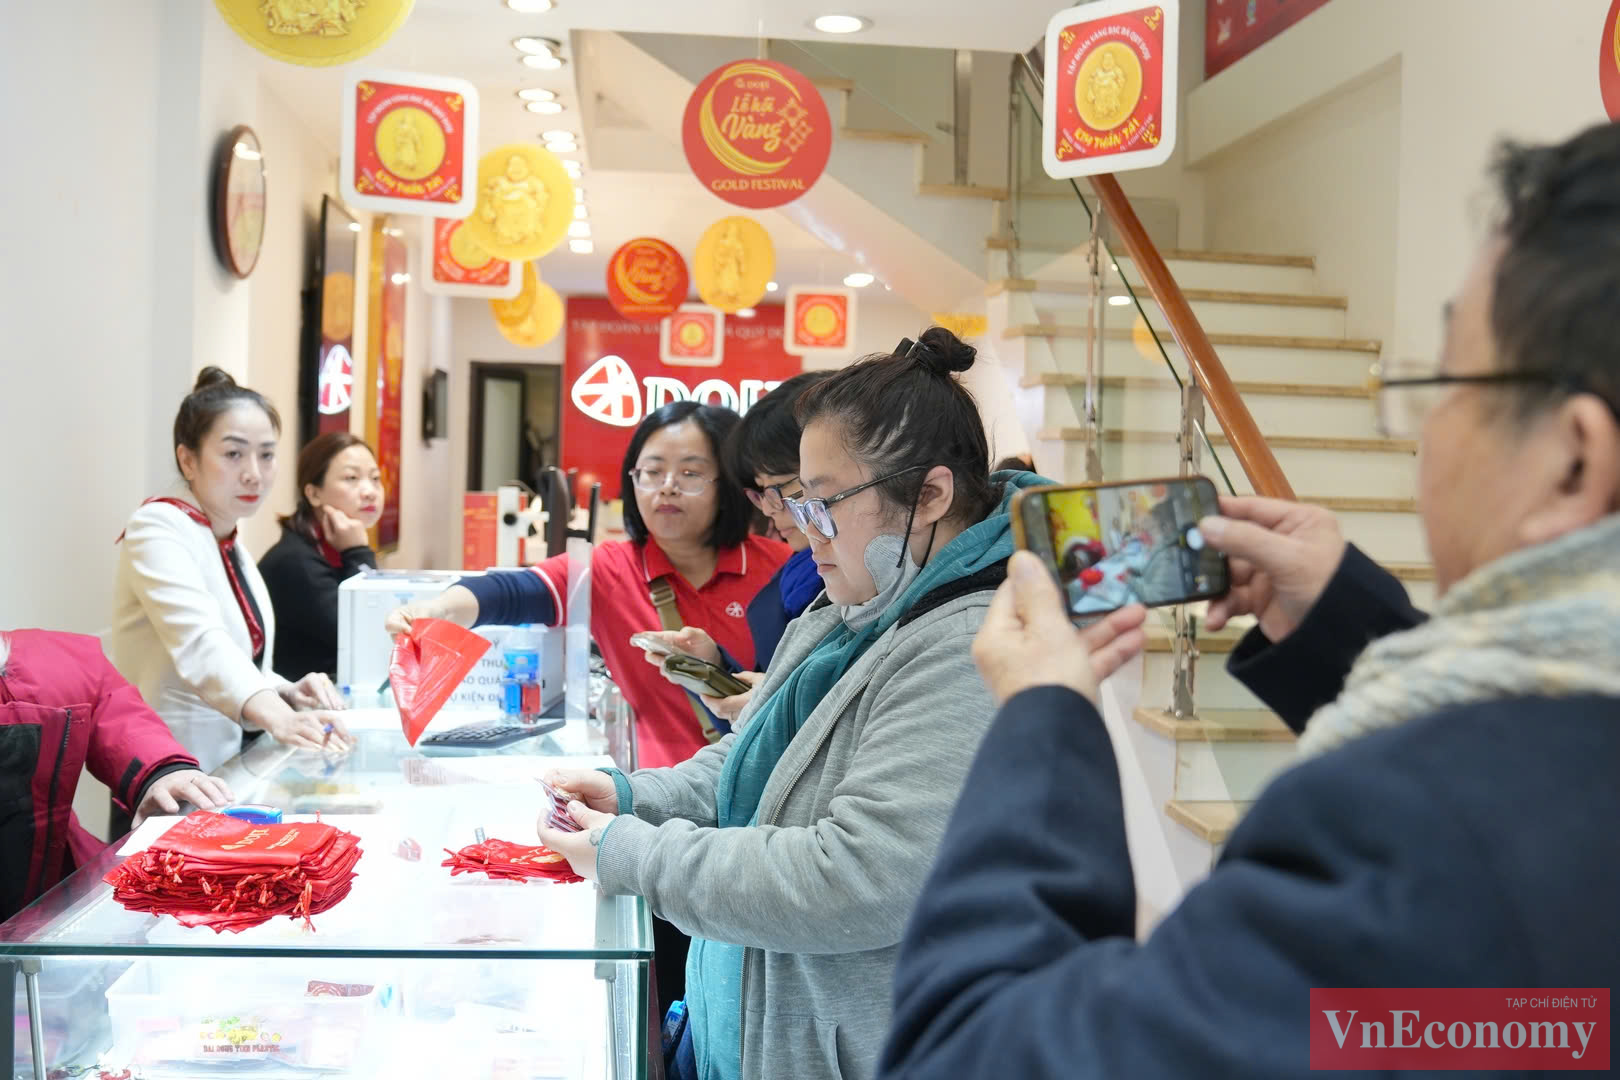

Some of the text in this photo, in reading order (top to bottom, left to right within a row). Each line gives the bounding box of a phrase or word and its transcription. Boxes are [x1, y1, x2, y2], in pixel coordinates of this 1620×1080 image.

[720, 112, 786, 153] Vàng
[711, 177, 804, 192] GOLD FESTIVAL
